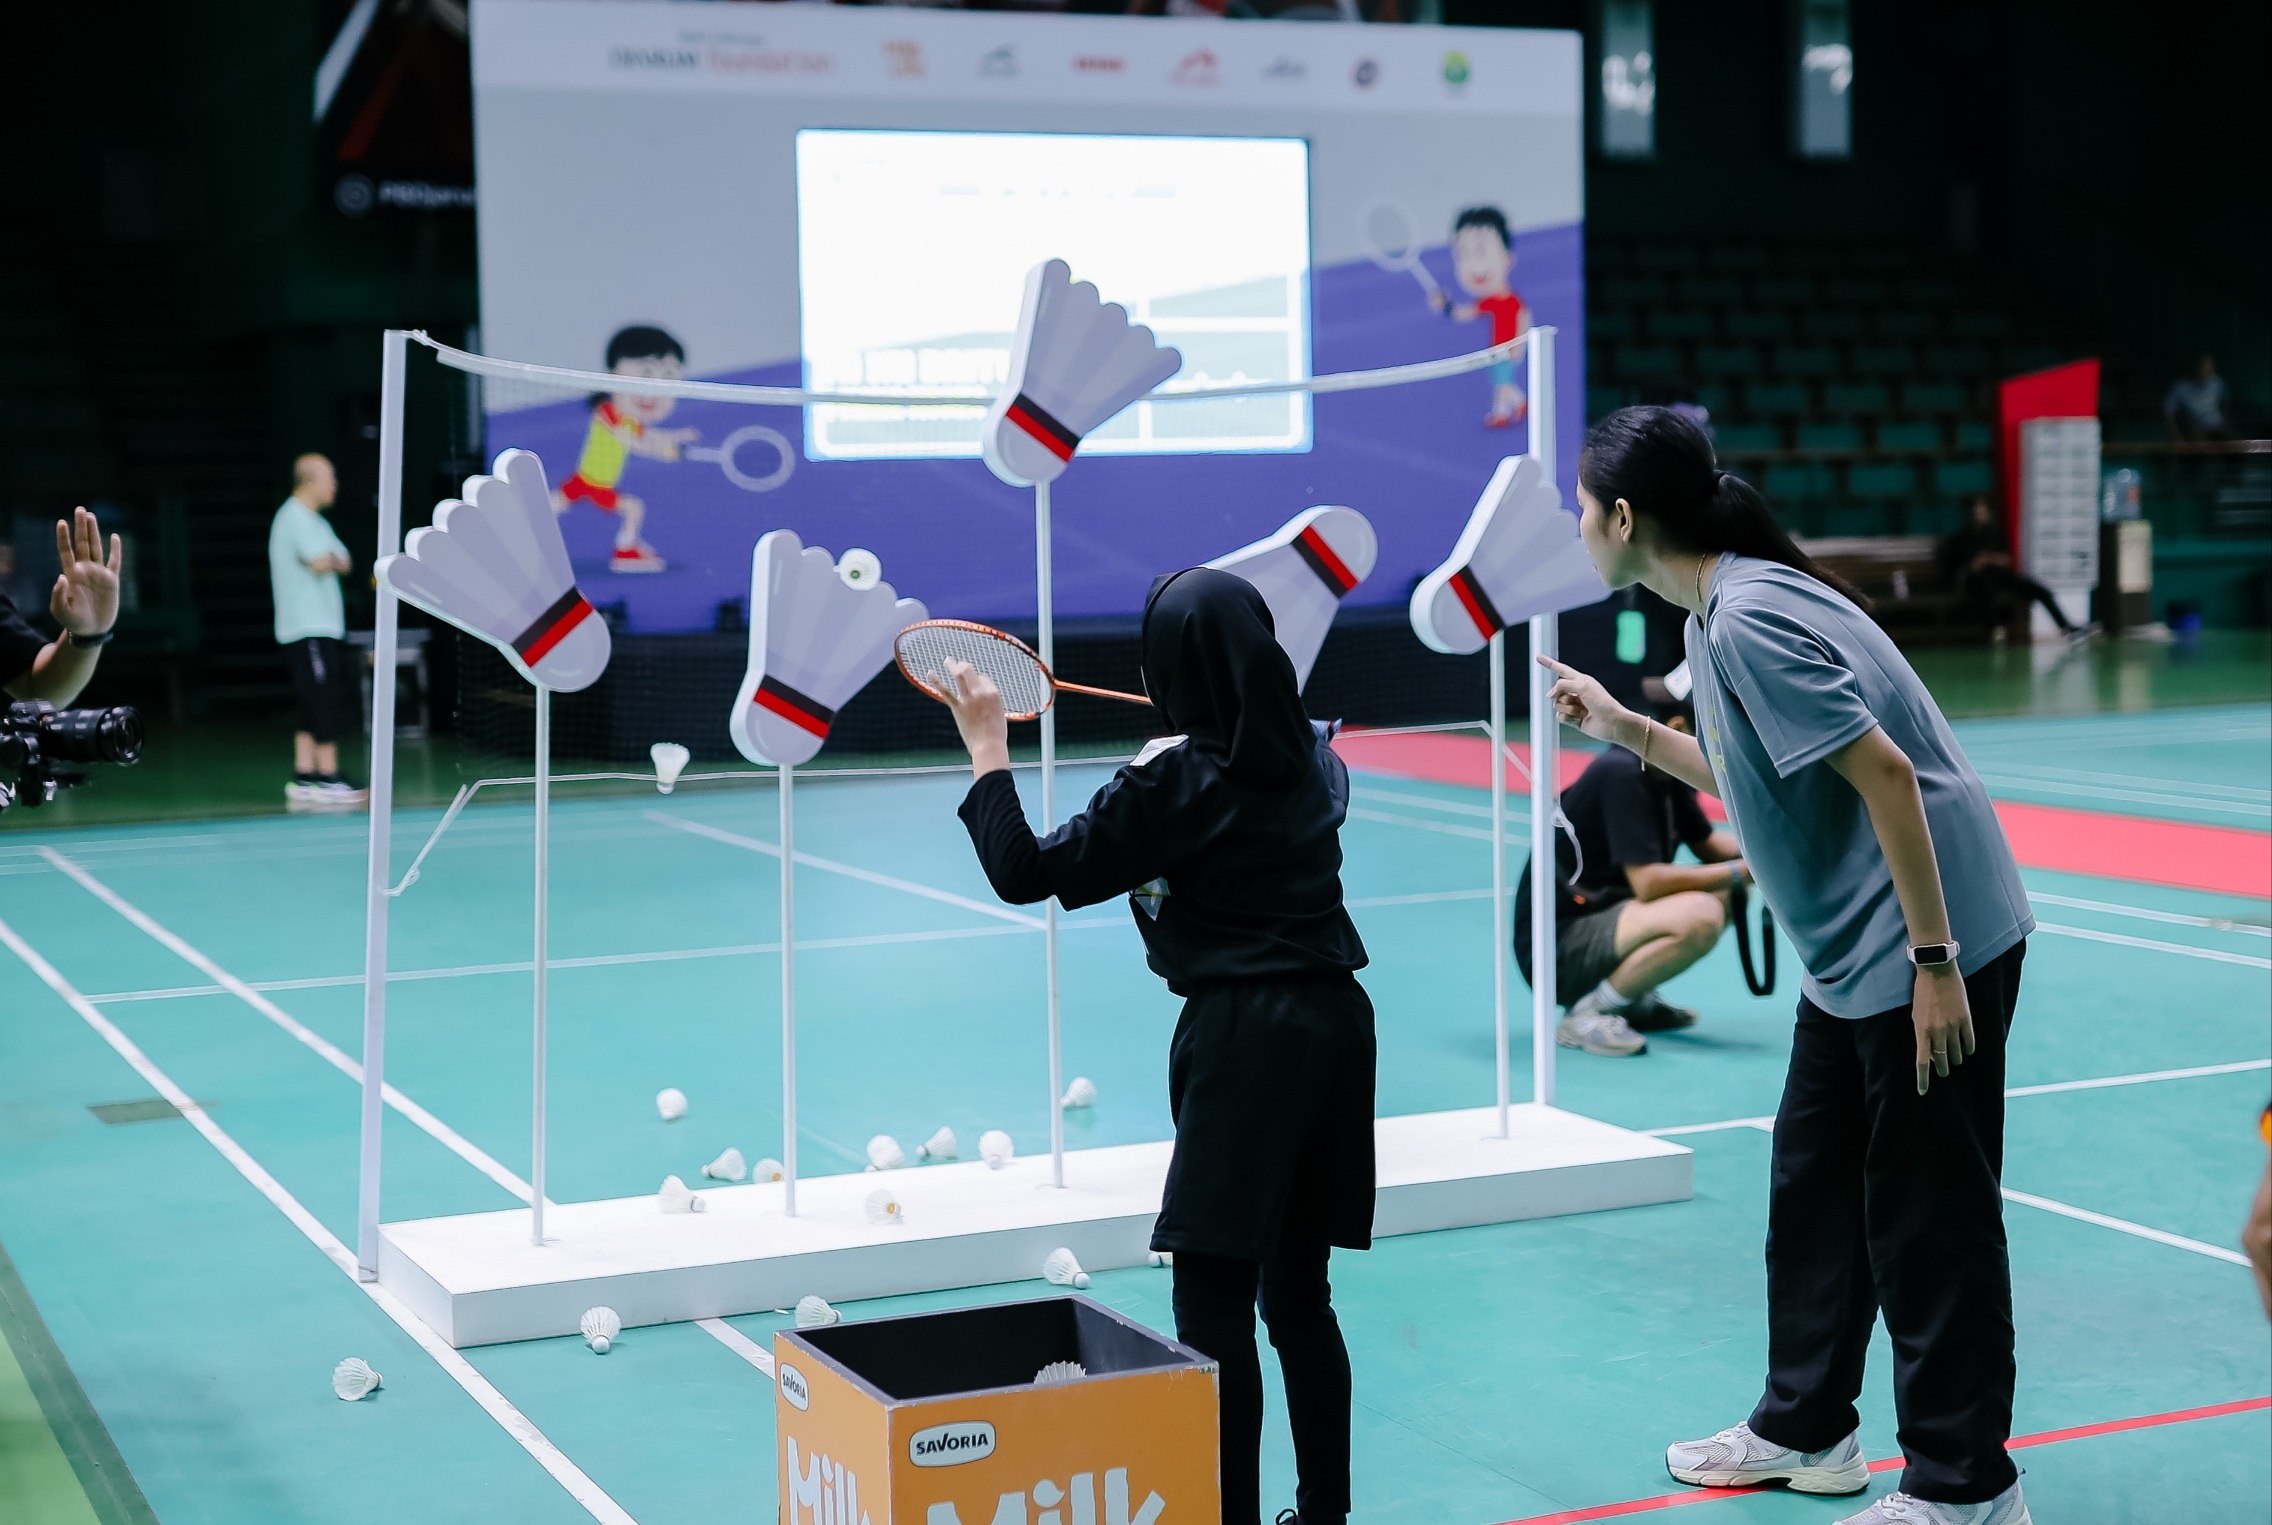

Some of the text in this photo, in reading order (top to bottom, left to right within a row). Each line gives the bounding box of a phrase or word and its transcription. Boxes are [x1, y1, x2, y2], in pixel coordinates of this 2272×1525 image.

[782, 1373, 806, 1402] SAVORIA
[916, 1432, 989, 1456] SAVORIA
[926, 1466, 1167, 1525] ilk
